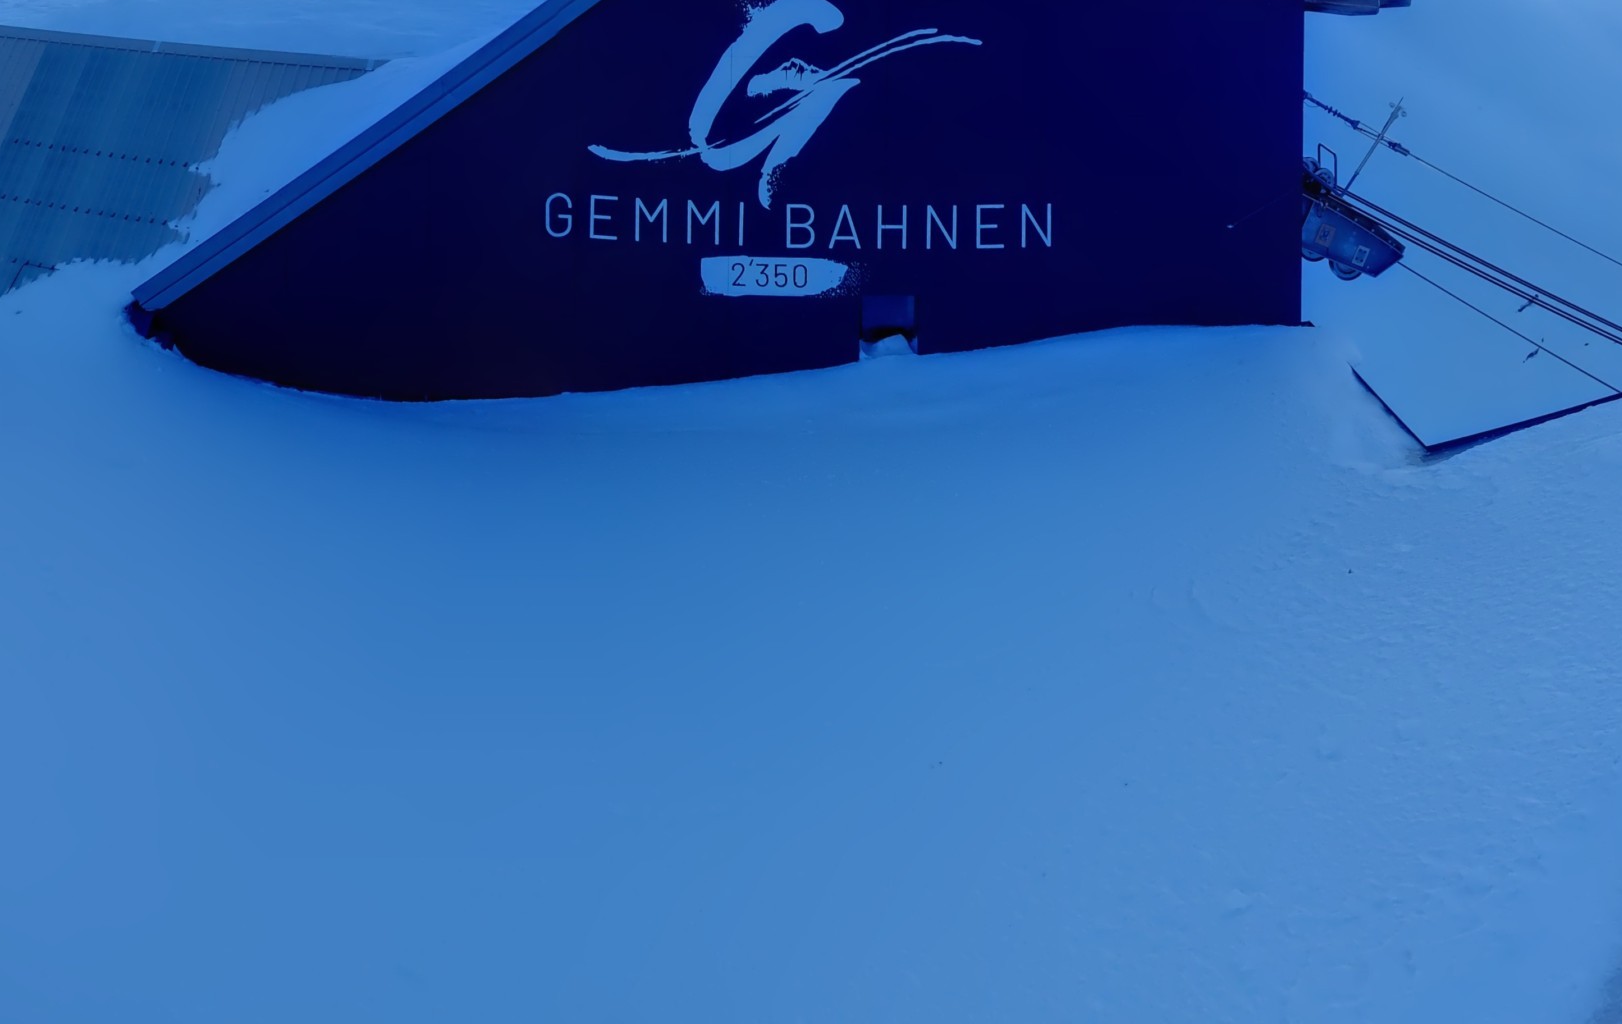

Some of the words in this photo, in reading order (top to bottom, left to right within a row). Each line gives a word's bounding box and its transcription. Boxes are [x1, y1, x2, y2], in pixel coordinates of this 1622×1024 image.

[546, 193, 744, 245] GEMMI
[787, 204, 1051, 249] BAHNEN
[732, 259, 807, 288] 2'350
